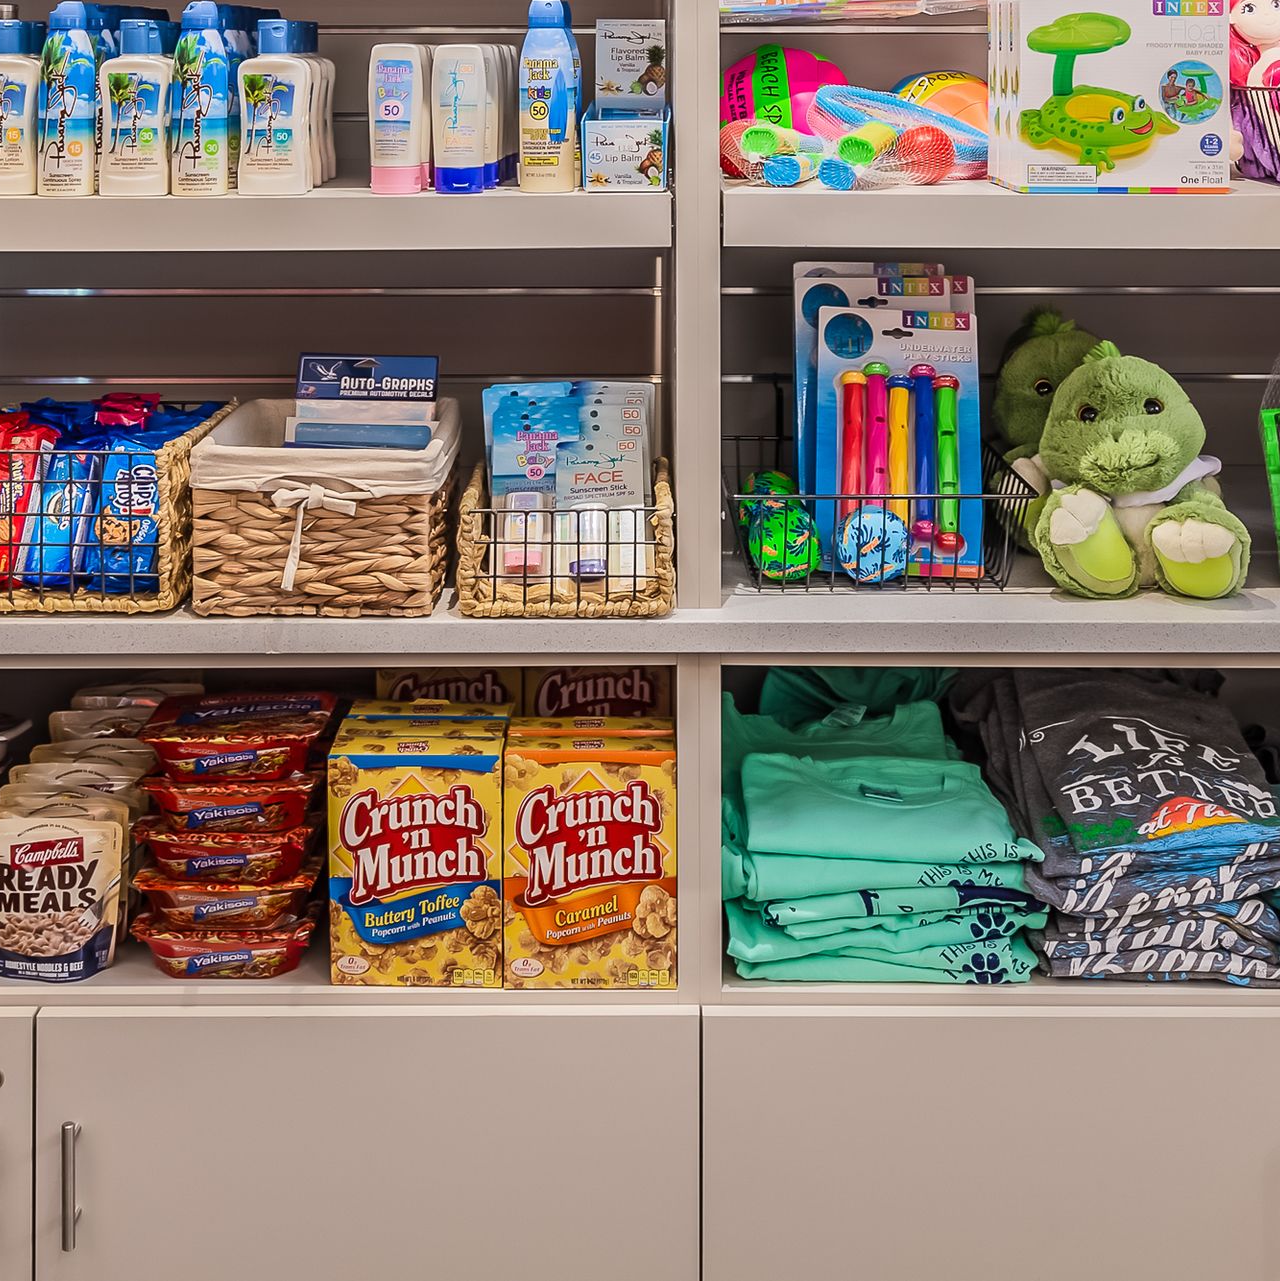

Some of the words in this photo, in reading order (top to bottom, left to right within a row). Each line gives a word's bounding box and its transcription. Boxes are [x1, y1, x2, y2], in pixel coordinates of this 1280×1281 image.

[611, 47, 645, 55] Flavored
[611, 54, 624, 62] Lip
[527, 68, 551, 82] Jack
[377, 86, 409, 101] Baby
[527, 86, 551, 100] kids
[384, 105, 400, 116] 50
[531, 104, 546, 117] 50
[8, 131, 18, 139] 15
[141, 132, 153, 141] 30
[276, 132, 288, 141] 50
[69, 144, 81, 154] 15
[605, 154, 619, 163] Lip
[620, 154, 642, 162] Balm
[1180, 176, 1199, 184] One
[1201, 176, 1223, 184] Float
[905, 315, 967, 329] INTEX
[899, 343, 971, 354] UNDERWATER
[903, 352, 930, 361] PLAY
[933, 354, 972, 363] STICKS
[340, 376, 434, 391] AUTO-GRAPHS
[623, 410, 639, 418] 50
[619, 441, 635, 450] 50
[516, 454, 554, 468] Baby
[529, 468, 542, 476] 50
[575, 471, 623, 485] FACE
[570, 486, 608, 494] Sunscreen
[1067, 724, 1240, 771] LIFE
[199, 751, 255, 767] Yakisoba
[1061, 770, 1277, 819] BETTER
[194, 805, 259, 821] Yakisoba
[343, 789, 480, 847] Crunch
[520, 784, 654, 846] Crunch
[1137, 811, 1173, 836] at
[13, 839, 81, 865] Campbell's
[191, 857, 244, 870] Yakisoba
[356, 836, 480, 898] Munch
[532, 835, 656, 898] Munch
[364, 907, 415, 928] Buttery
[419, 895, 460, 915] Toffee
[555, 896, 618, 927] Caramel
[371, 923, 406, 938] Popcorn
[422, 912, 456, 927] Peanuts
[5, 959, 35, 970] HOMESTYLE
[37, 961, 62, 971] NOODLES
[70, 961, 84, 971] BEEF
[193, 953, 249, 966] Yakisoba
